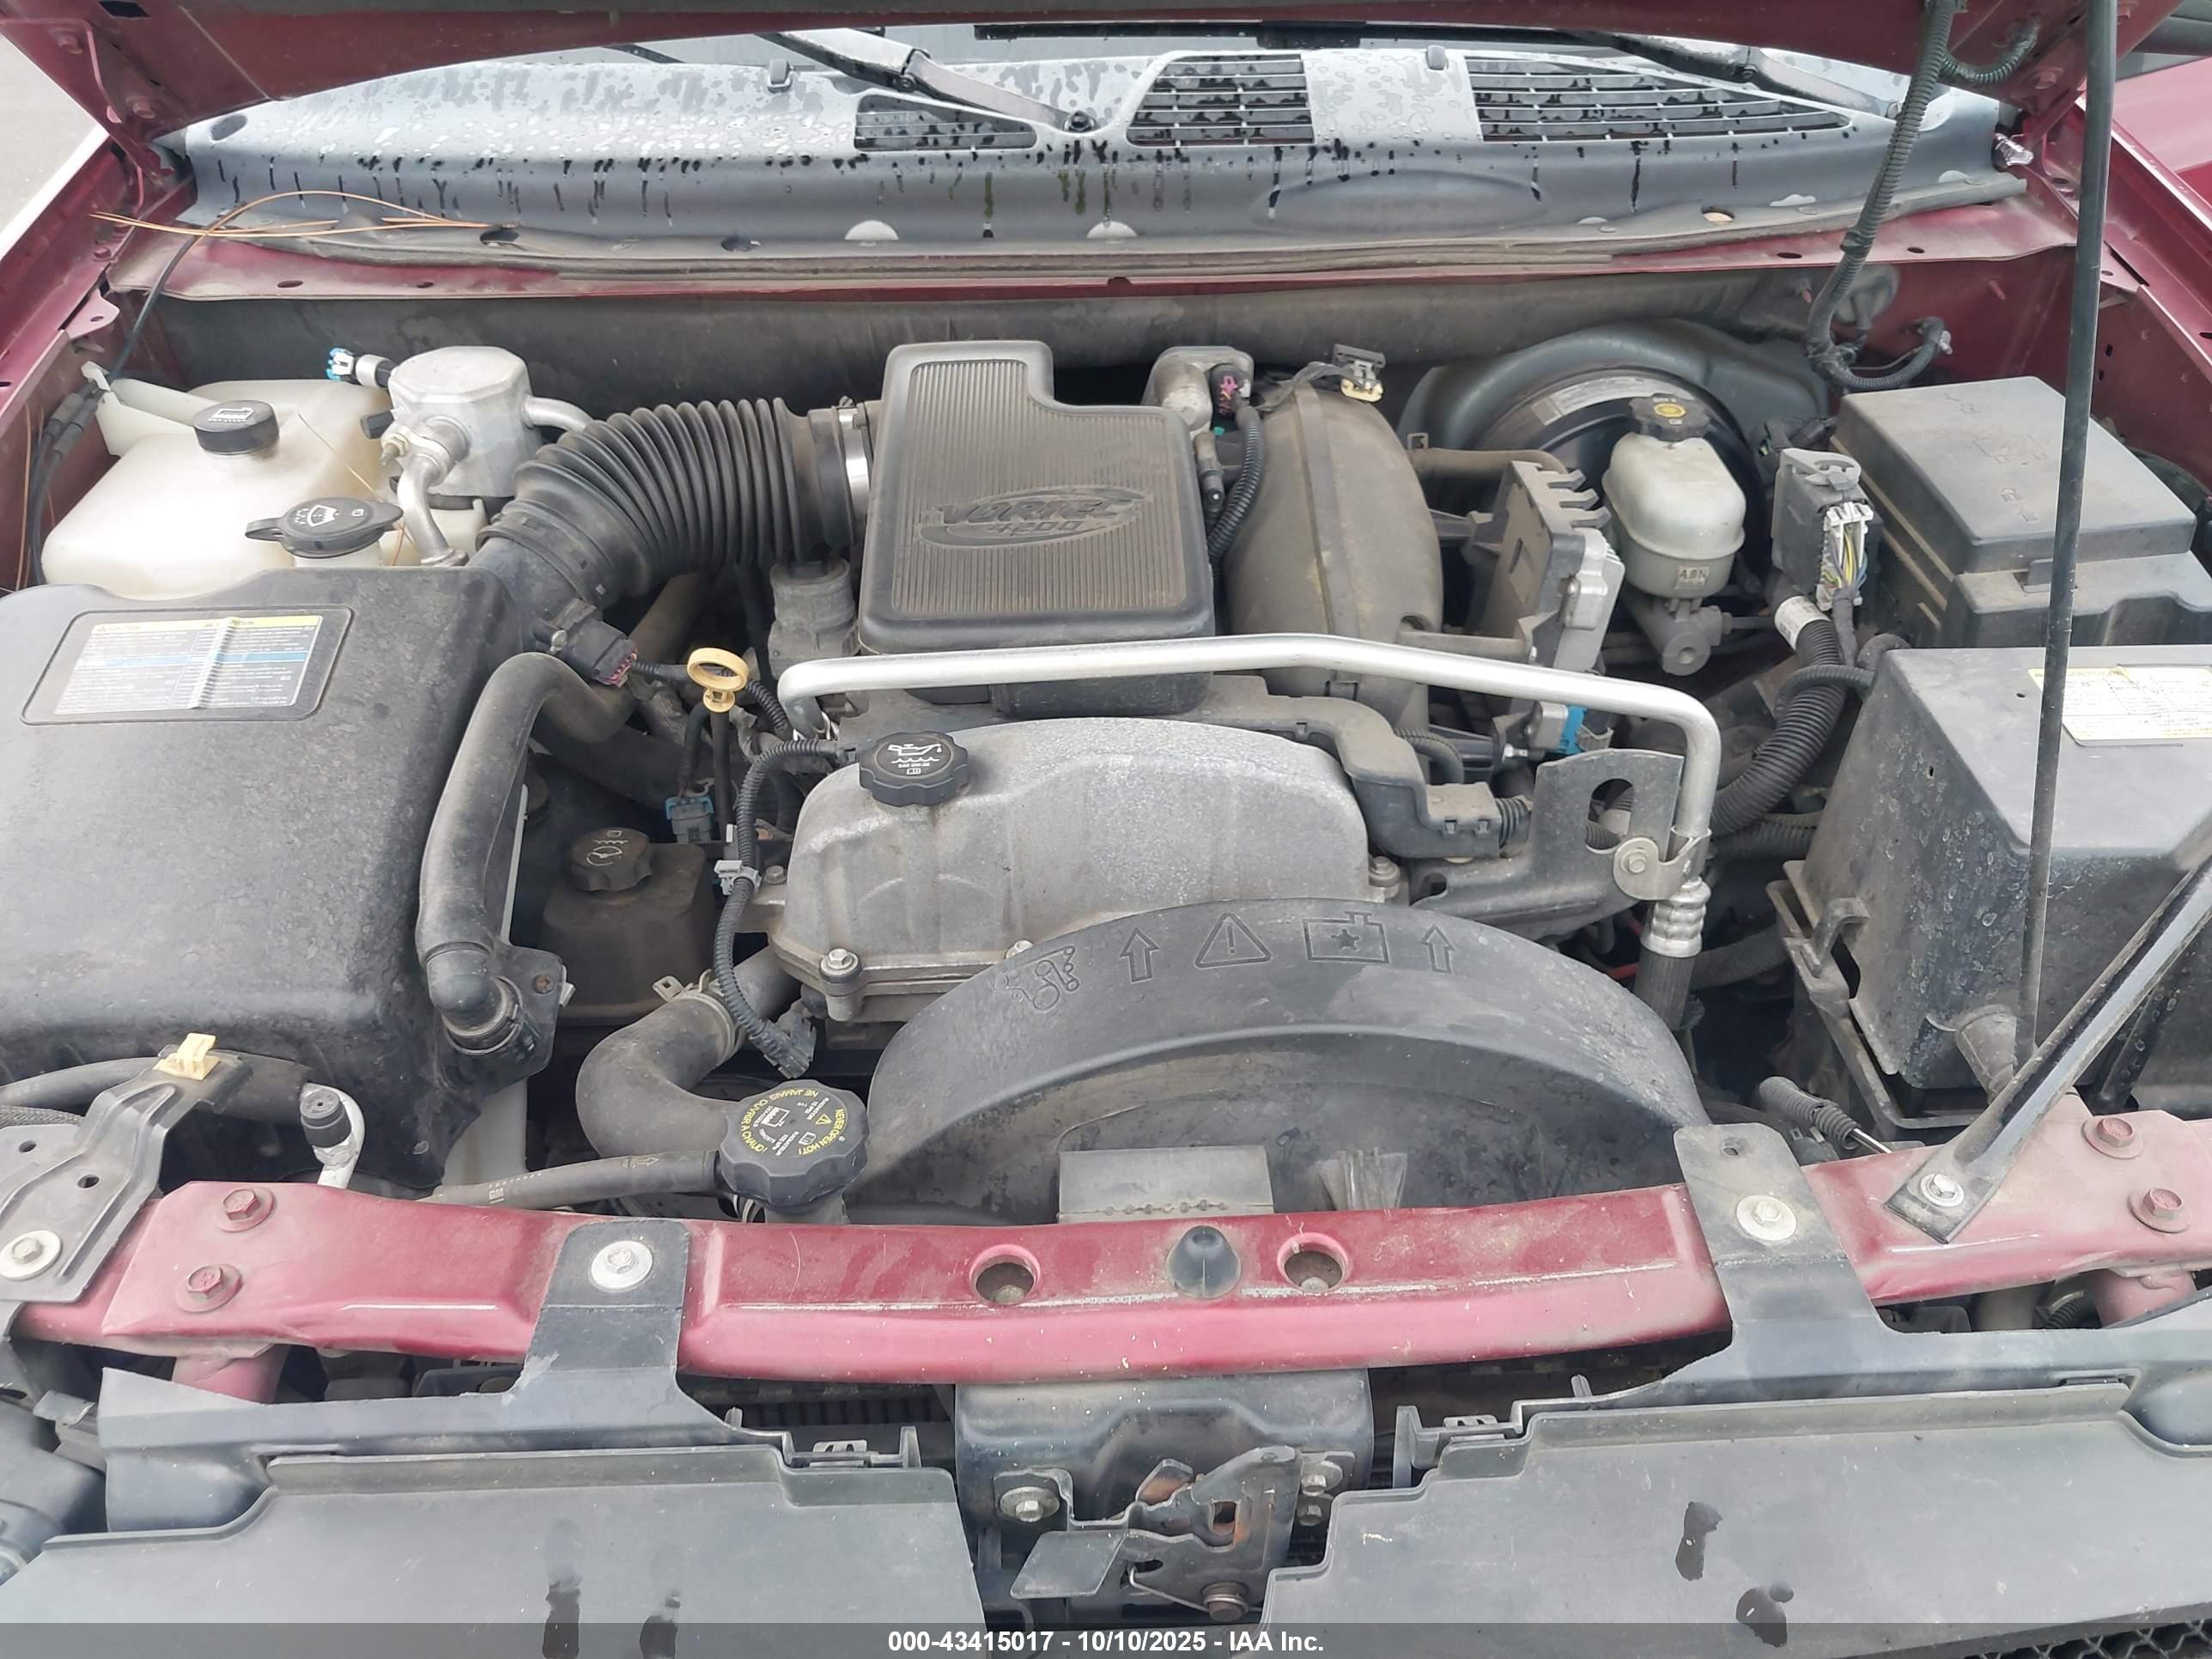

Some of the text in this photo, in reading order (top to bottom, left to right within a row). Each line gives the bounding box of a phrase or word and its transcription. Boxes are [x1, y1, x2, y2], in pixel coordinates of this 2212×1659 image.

[988, 520, 1085, 537] 4200
[769, 1089, 803, 1101] JAMAIS
[804, 1089, 819, 1098] NE
[742, 1098, 769, 1124] OUVRIR
[835, 1108, 846, 1128] NEVER
[818, 1126, 840, 1147] OPEN
